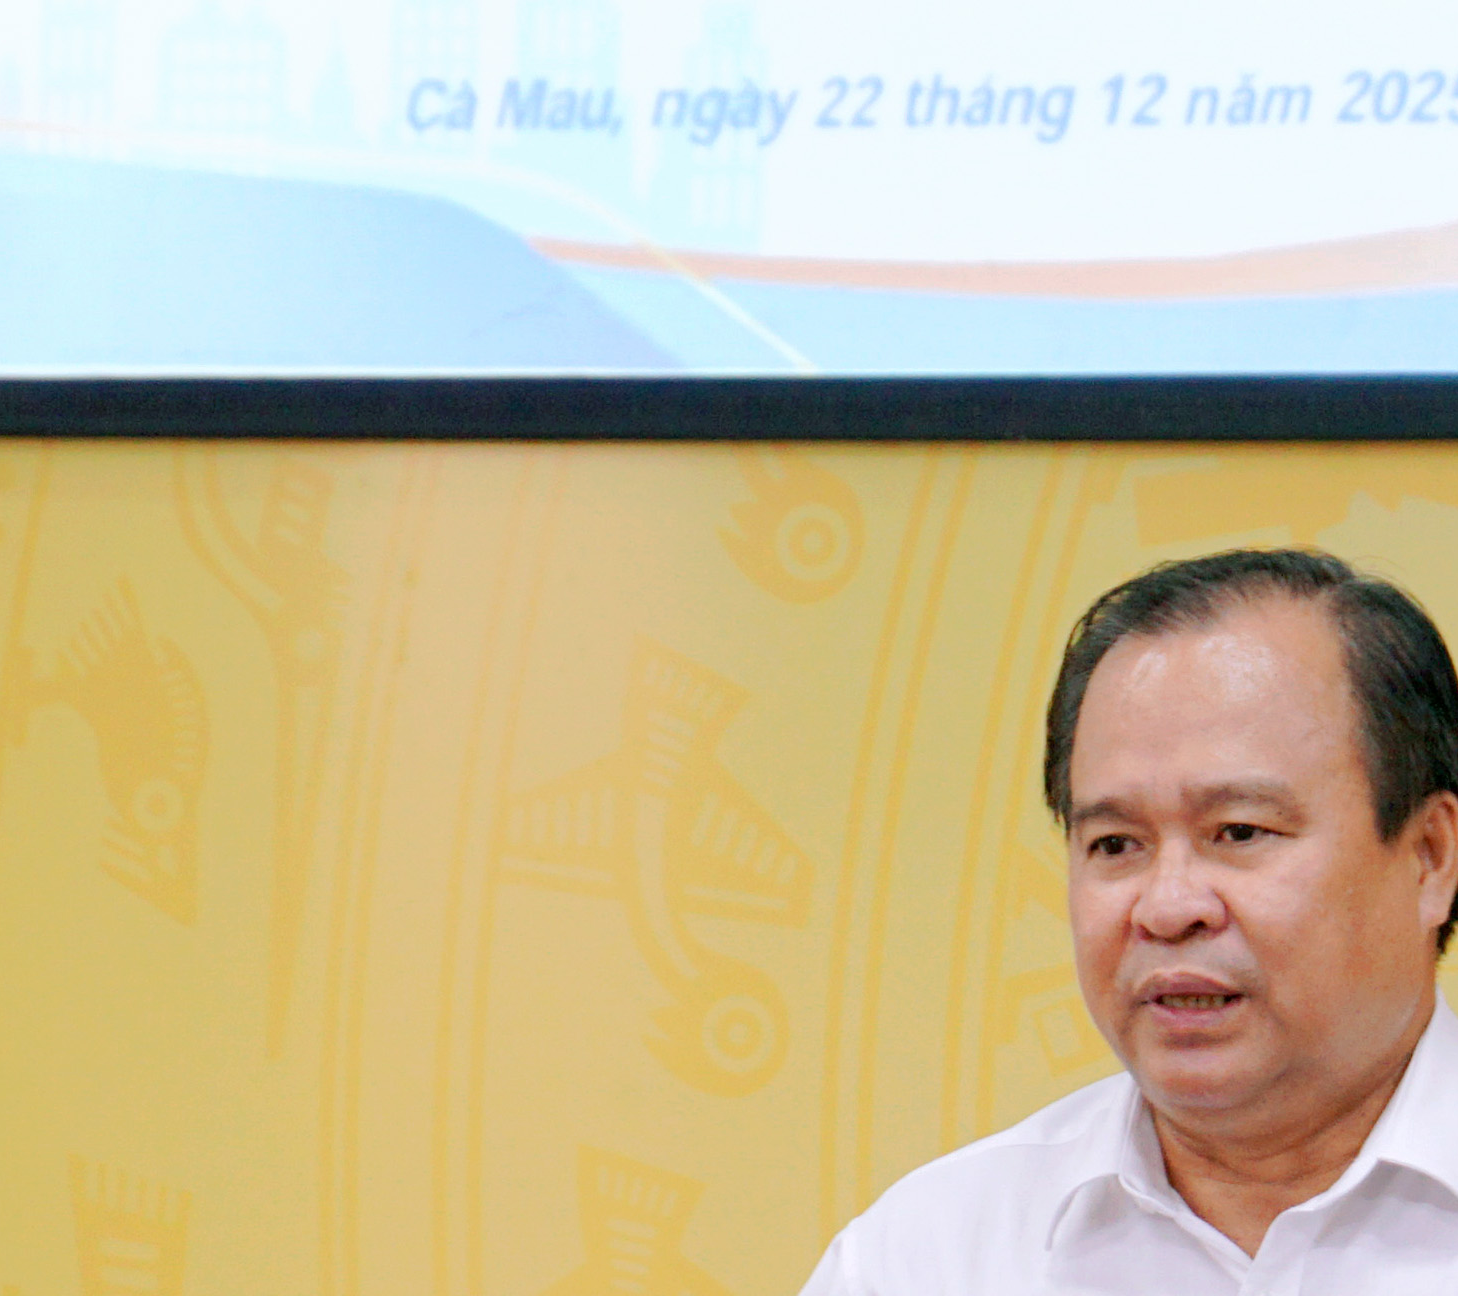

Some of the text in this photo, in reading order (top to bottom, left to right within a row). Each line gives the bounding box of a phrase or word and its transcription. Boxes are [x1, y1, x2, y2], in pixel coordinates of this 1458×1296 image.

[405, 77, 478, 134] Cà
[499, 77, 623, 137] Mau,
[654, 79, 798, 147] ngày
[815, 75, 885, 130] 22
[904, 73, 1077, 145] tháng
[1103, 72, 1168, 127] 12
[1184, 73, 1313, 127] năm
